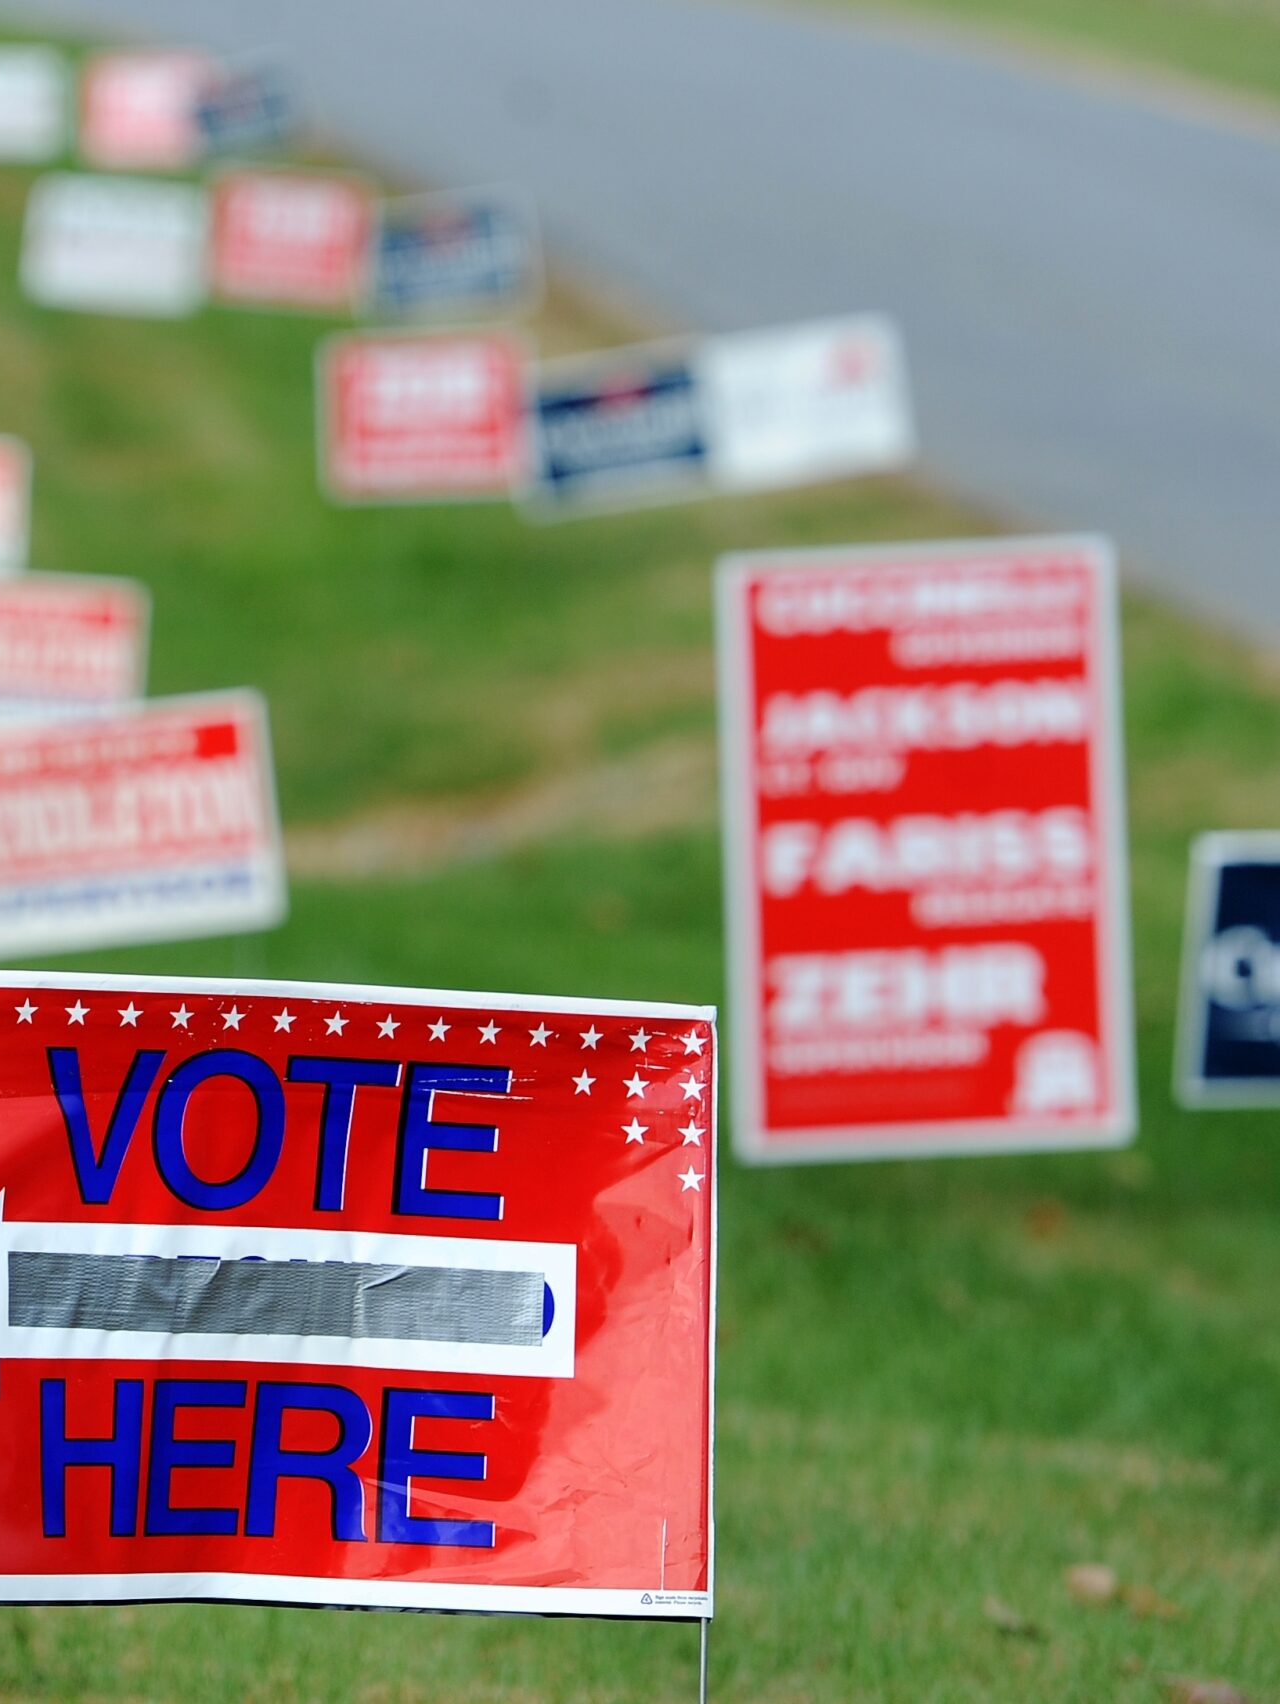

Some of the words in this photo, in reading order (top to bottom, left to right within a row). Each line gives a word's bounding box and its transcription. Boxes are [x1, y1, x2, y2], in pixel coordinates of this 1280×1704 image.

[762, 680, 1086, 760] JACKSON
[765, 940, 1048, 1034] ZEHR
[46, 1047, 512, 1220] VOTE
[39, 1378, 495, 1547] HERE
